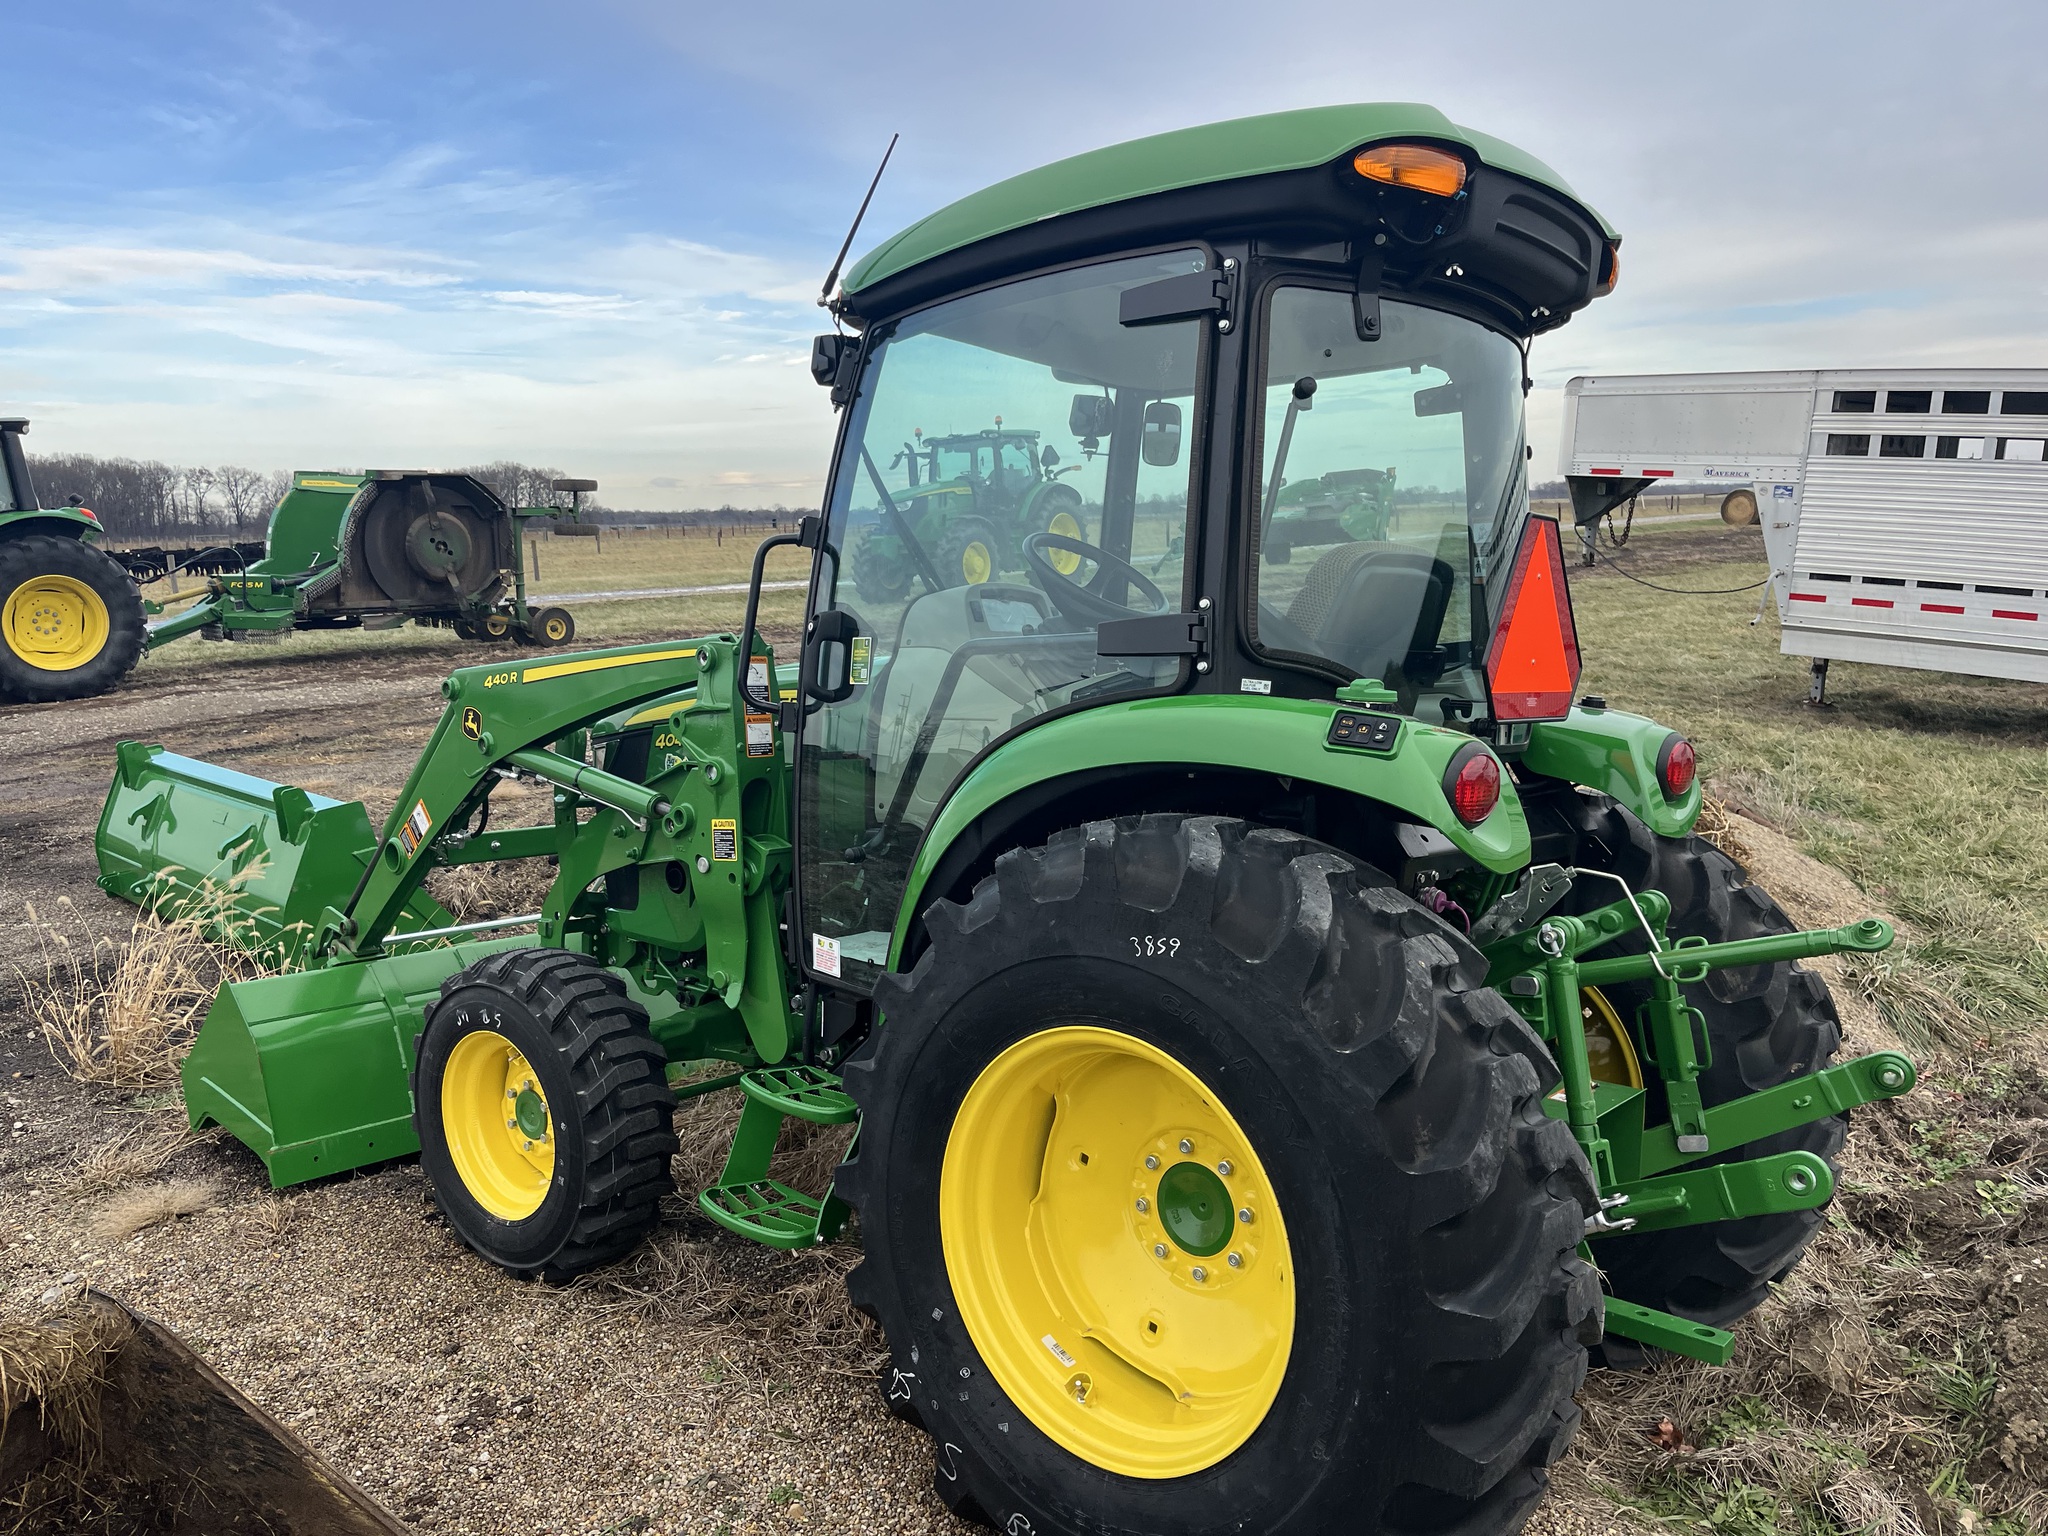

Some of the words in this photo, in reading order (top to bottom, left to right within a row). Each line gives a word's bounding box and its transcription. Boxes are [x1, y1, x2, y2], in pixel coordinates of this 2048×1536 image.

[1704, 467, 1750, 478] MAVERICK
[717, 820, 735, 828] CAUTION
[1129, 935, 1181, 958] 3859
[1161, 993, 1310, 1151] GALAXY
